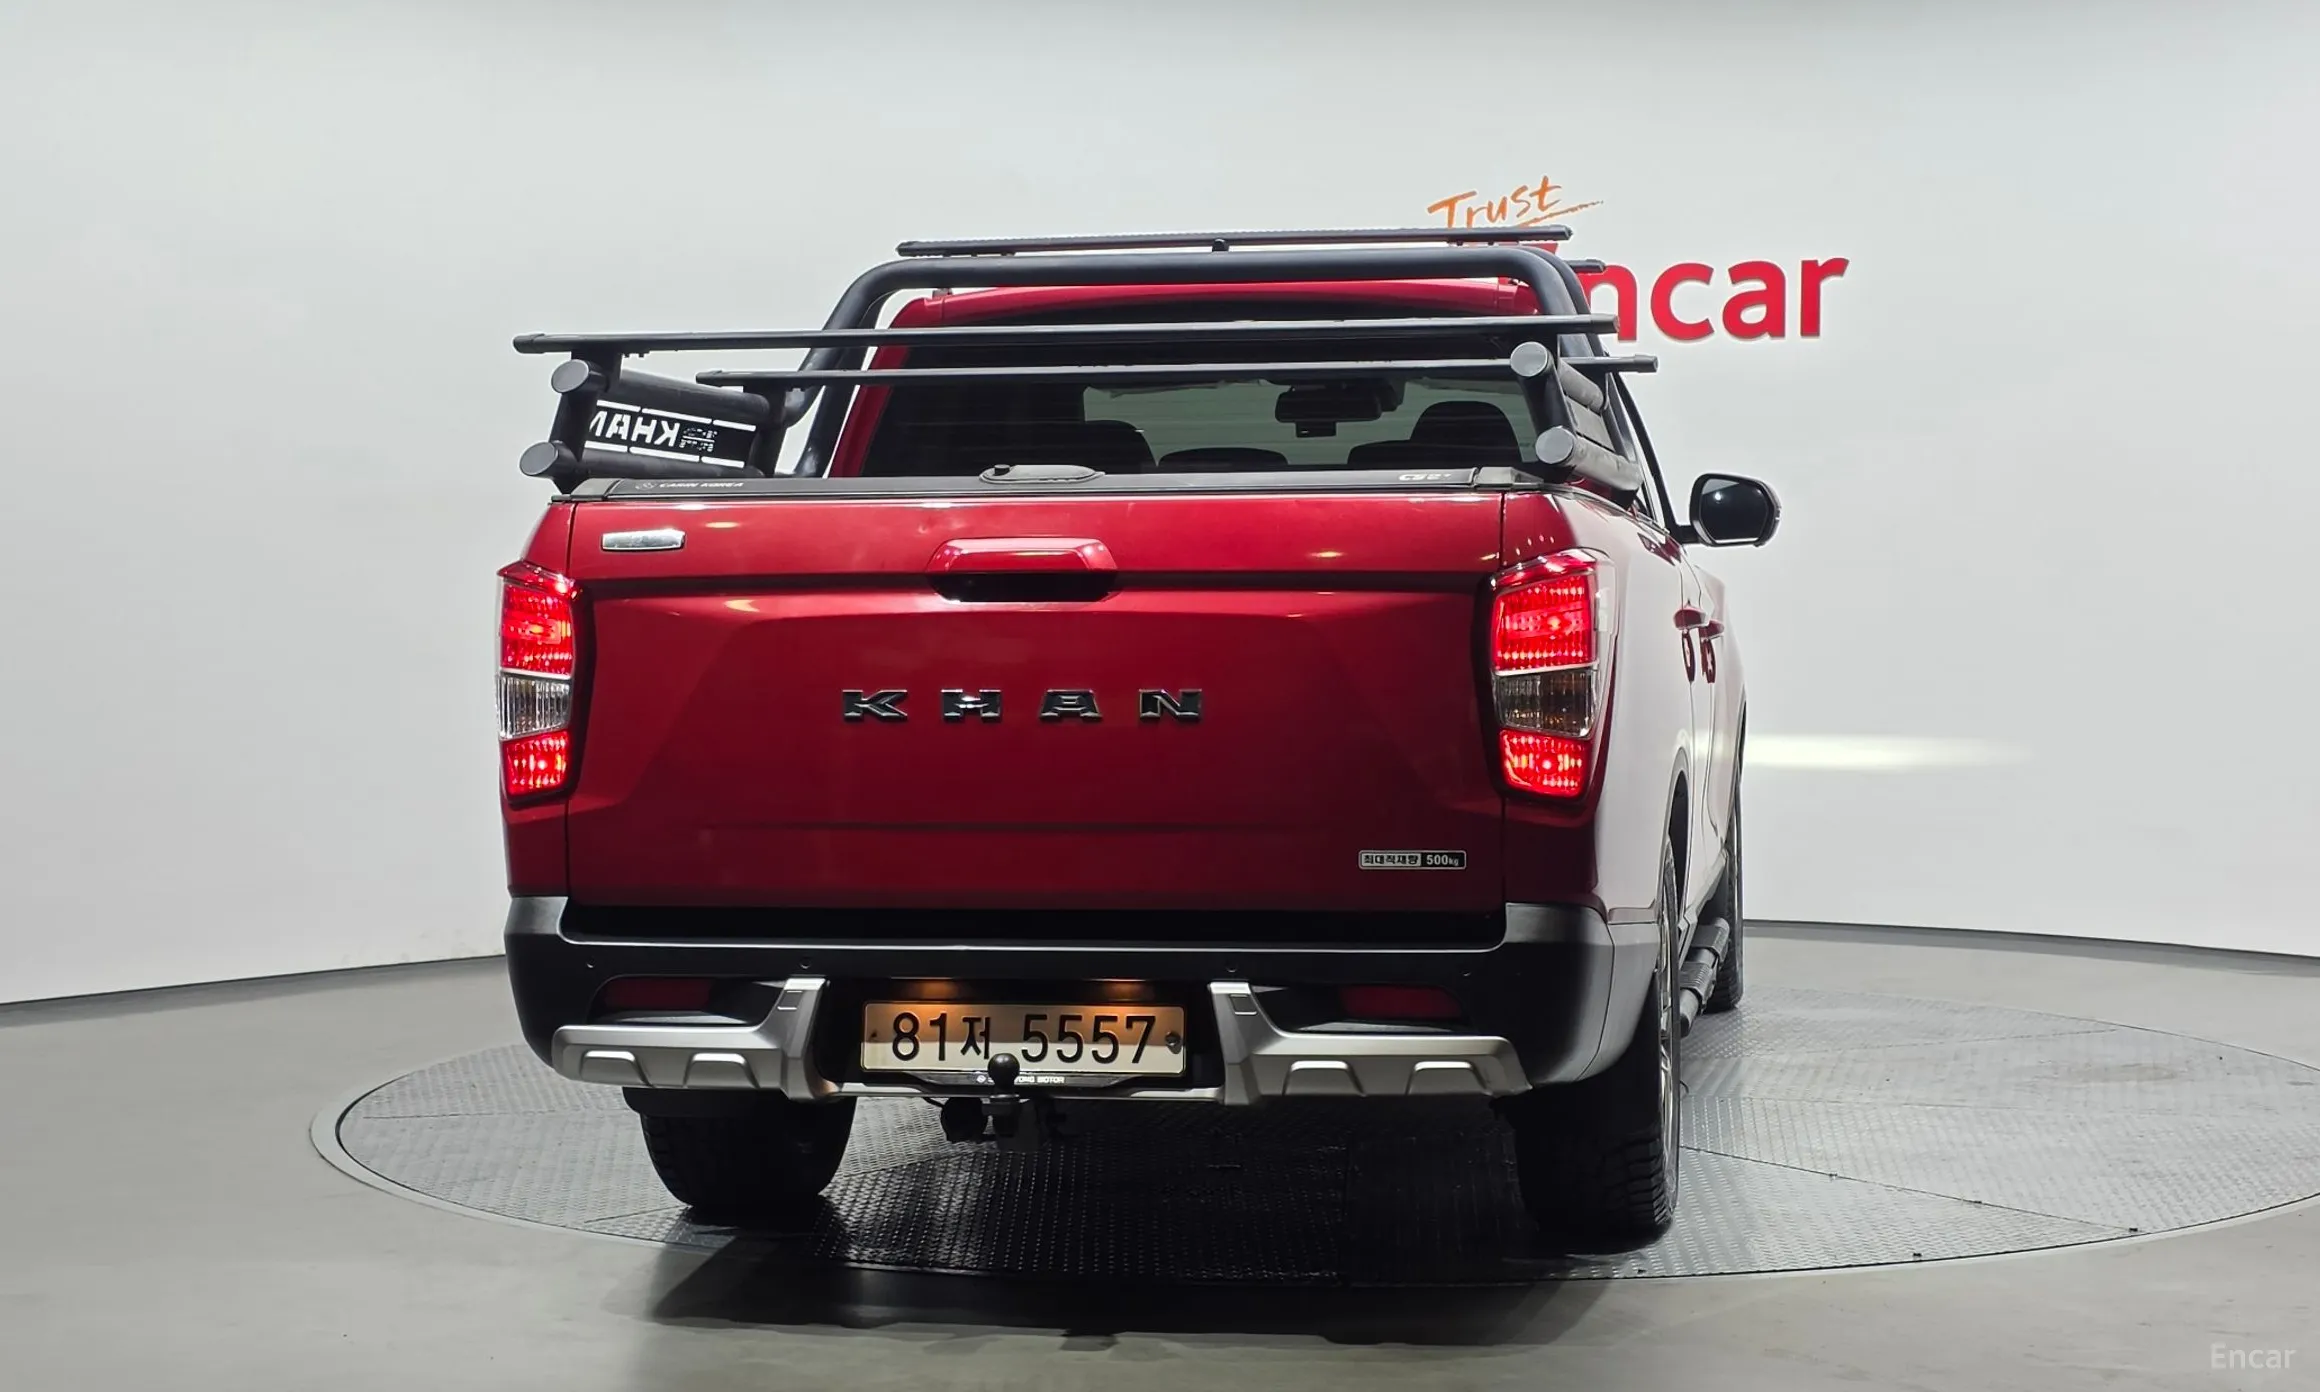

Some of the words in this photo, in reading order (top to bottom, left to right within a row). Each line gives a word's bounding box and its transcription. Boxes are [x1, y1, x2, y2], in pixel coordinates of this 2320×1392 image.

[1427, 176, 1562, 229] Trust
[1497, 243, 1850, 342] ncar
[842, 689, 1203, 720] KHAN
[1363, 854, 1420, 865] 최대적재량
[1426, 854, 1460, 867] 500kg
[892, 1011, 992, 1062] 81저
[1021, 1013, 1157, 1064] 5557
[1036, 1075, 1065, 1084] MOTOR
